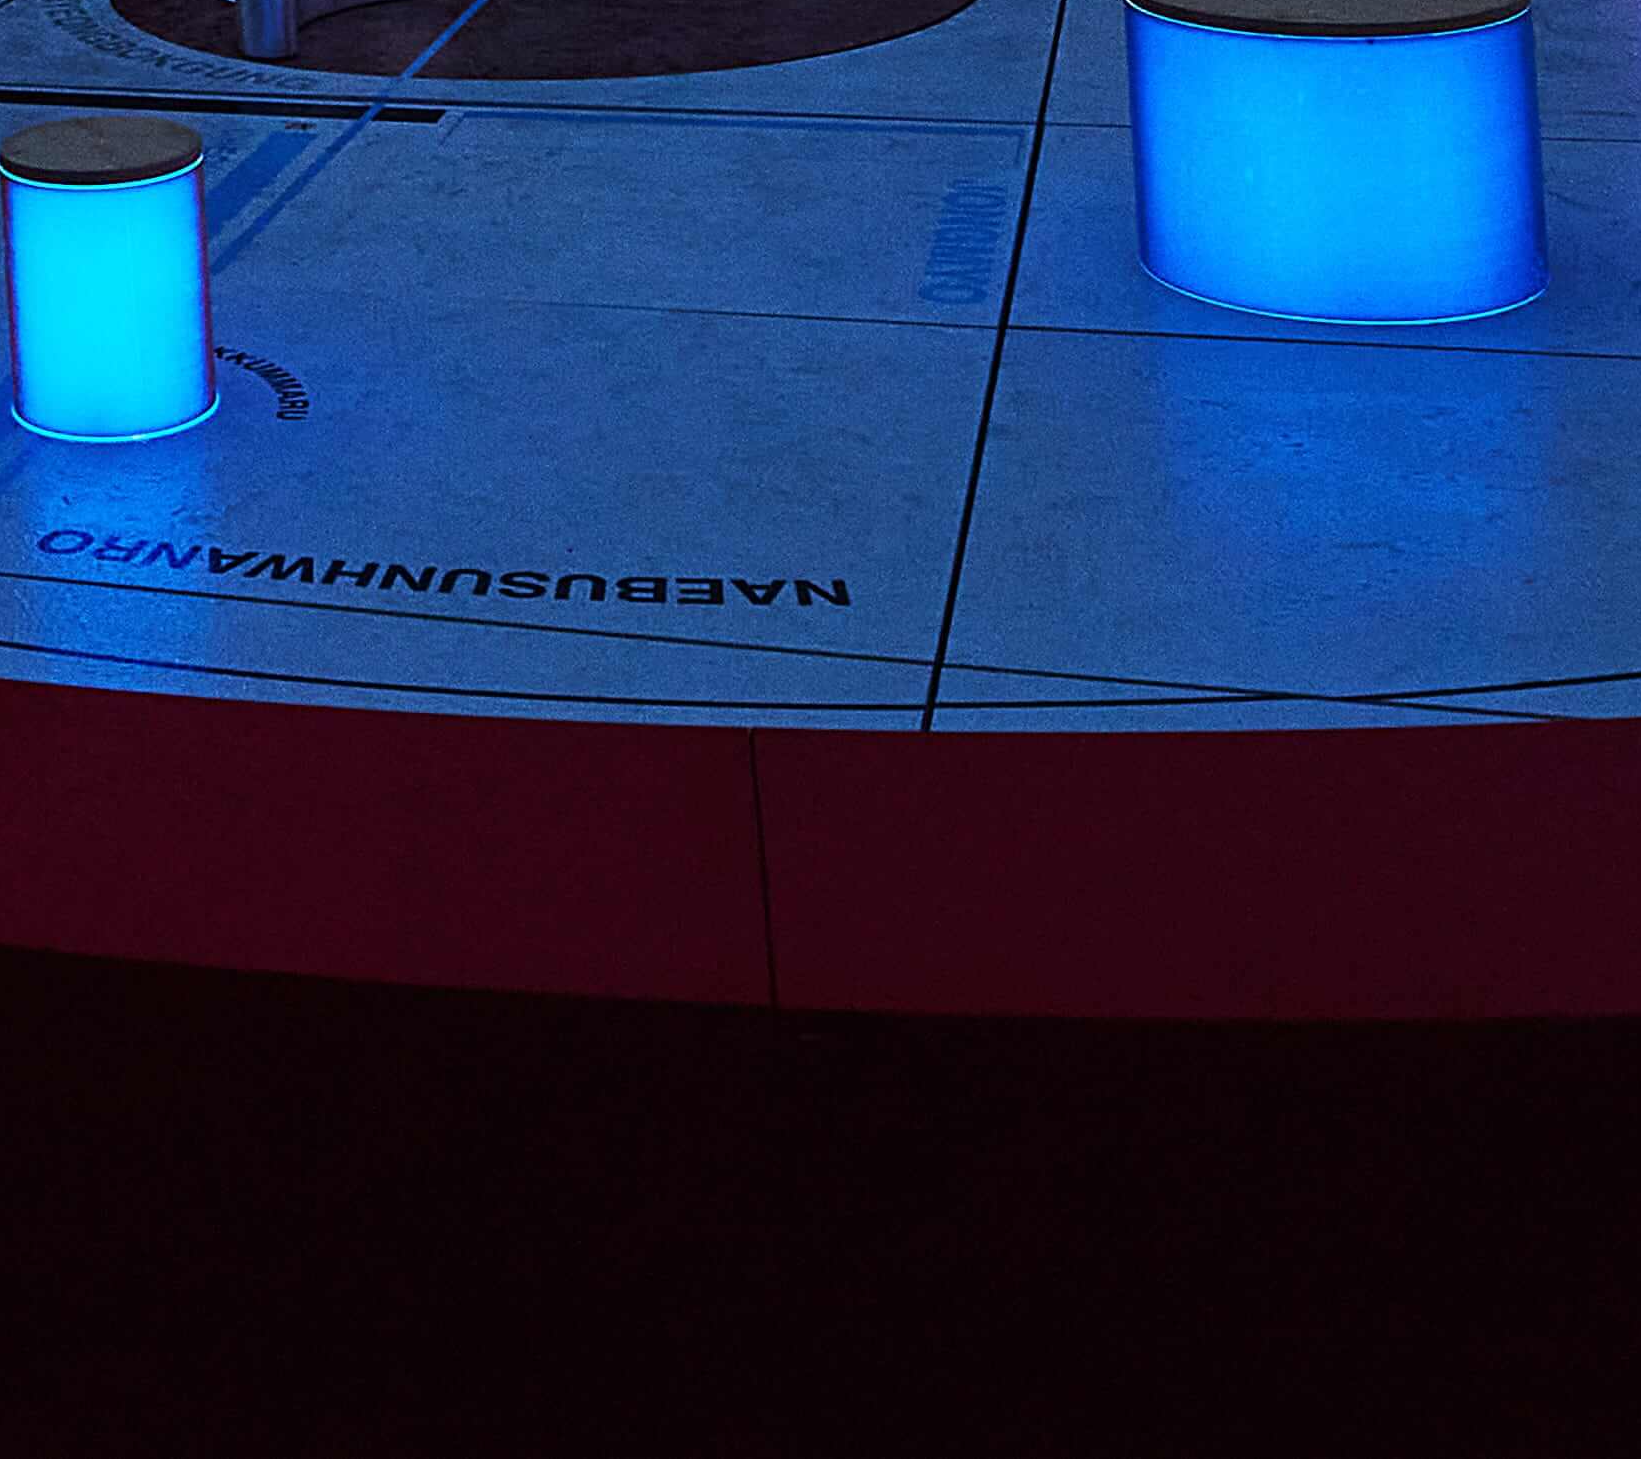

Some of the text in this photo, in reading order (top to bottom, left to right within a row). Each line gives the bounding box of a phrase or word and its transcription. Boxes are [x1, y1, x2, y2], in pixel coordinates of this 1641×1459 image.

[919, 179, 1007, 304] JONGMYO
[214, 346, 310, 420] KKUMMARU
[36, 527, 850, 609] NAEBUSUNHWANRO
